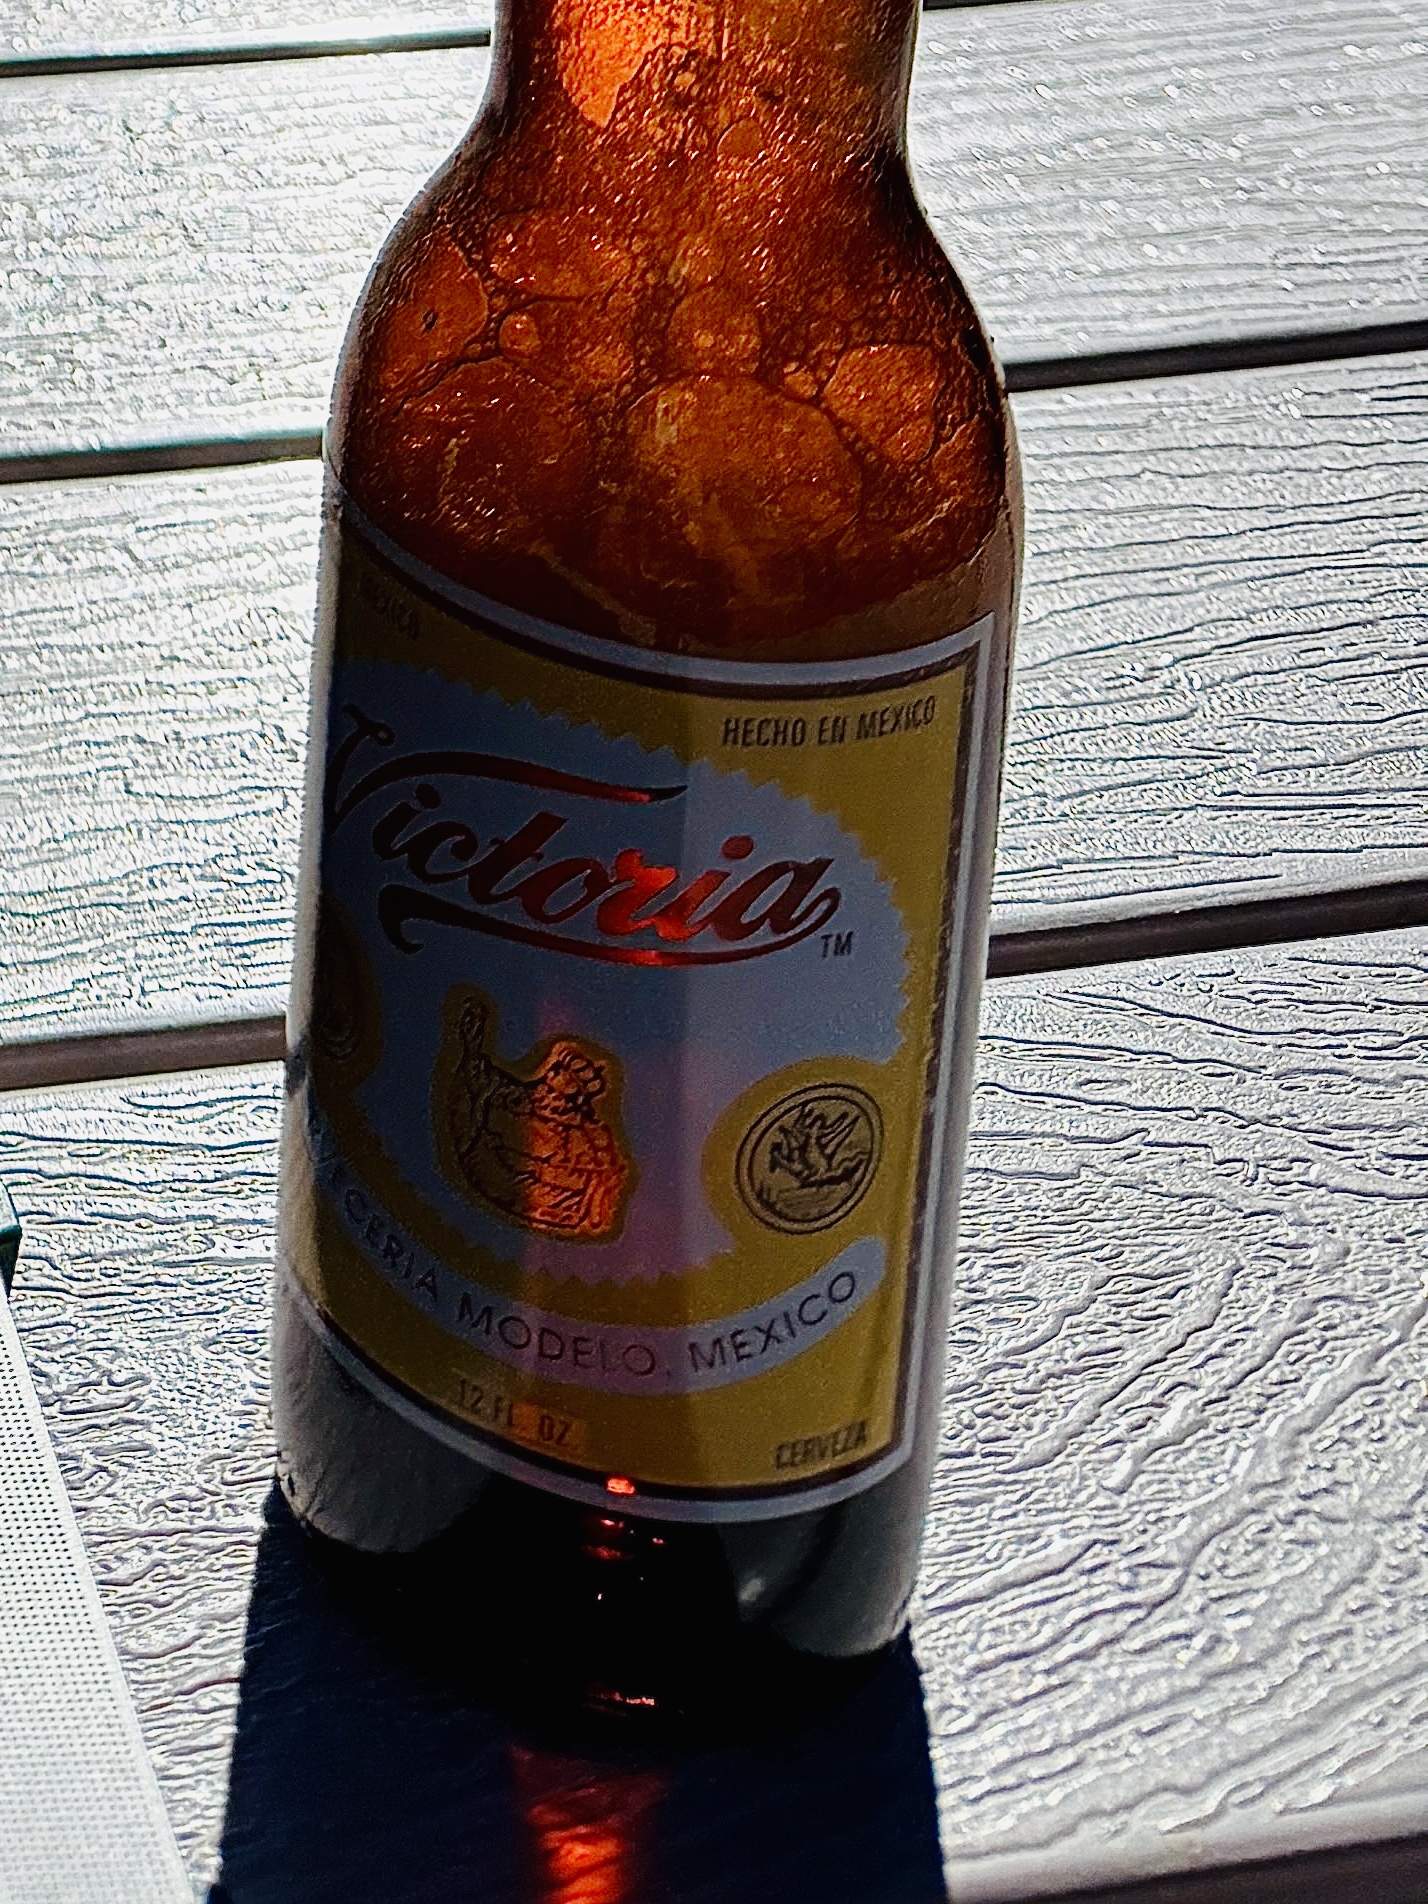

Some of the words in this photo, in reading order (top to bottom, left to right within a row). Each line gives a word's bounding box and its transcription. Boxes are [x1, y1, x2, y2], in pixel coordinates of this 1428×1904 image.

[722, 716, 806, 747] HECHO
[817, 714, 847, 744] EN
[855, 695, 936, 740] MEXICO
[327, 702, 841, 967] Victoria
[821, 933, 853, 956] TM
[689, 1272, 857, 1372] MEXICO
[775, 1418, 868, 1471] CERVEZA
